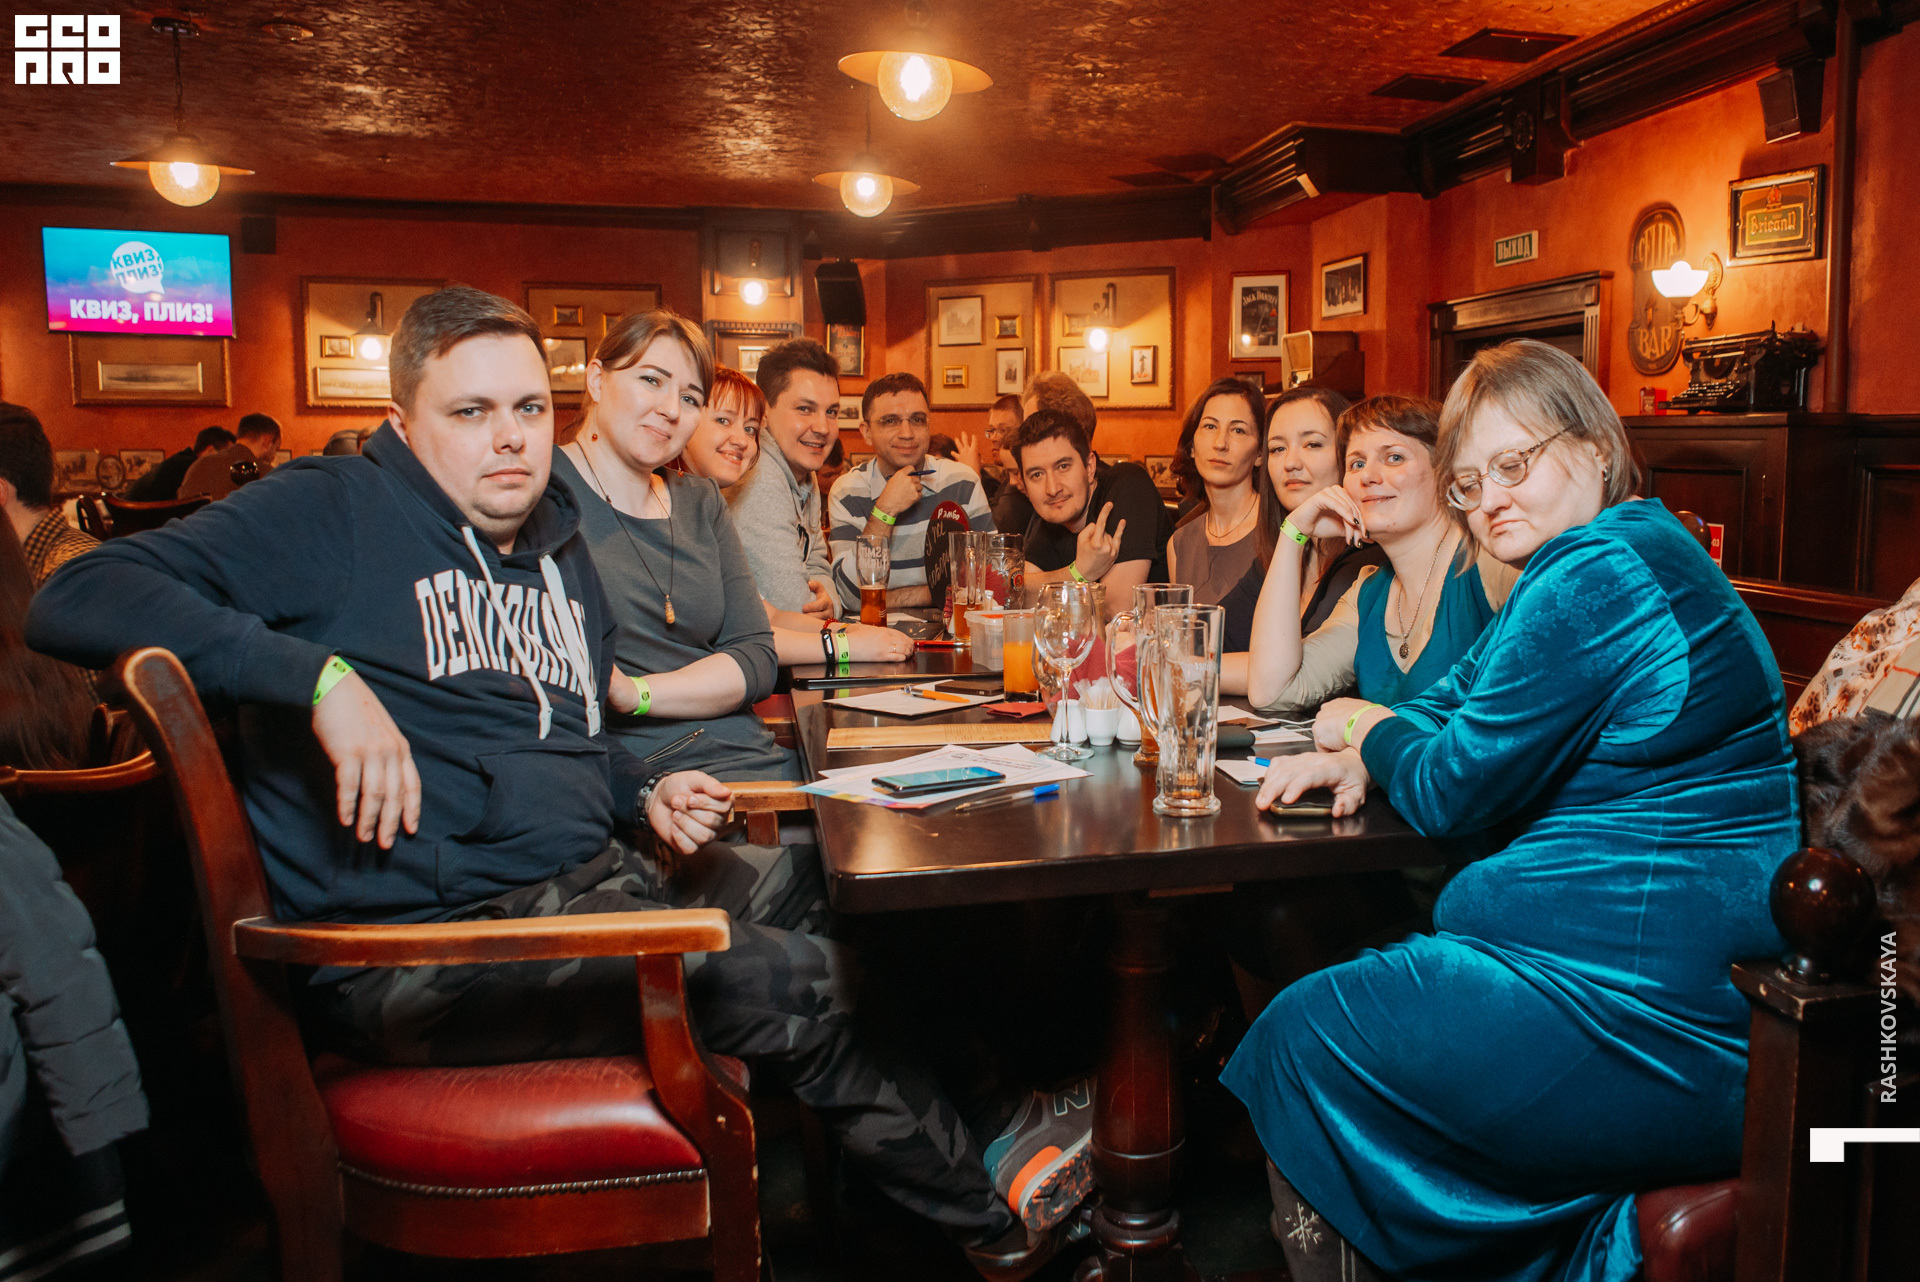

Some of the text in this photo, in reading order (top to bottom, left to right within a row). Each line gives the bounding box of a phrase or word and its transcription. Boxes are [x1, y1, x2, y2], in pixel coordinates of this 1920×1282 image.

[1497, 235, 1531, 261] ВЫХОД
[69, 298, 214, 324] КВИЗ, ПЛИЗ!
[1639, 325, 1672, 359] BAR
